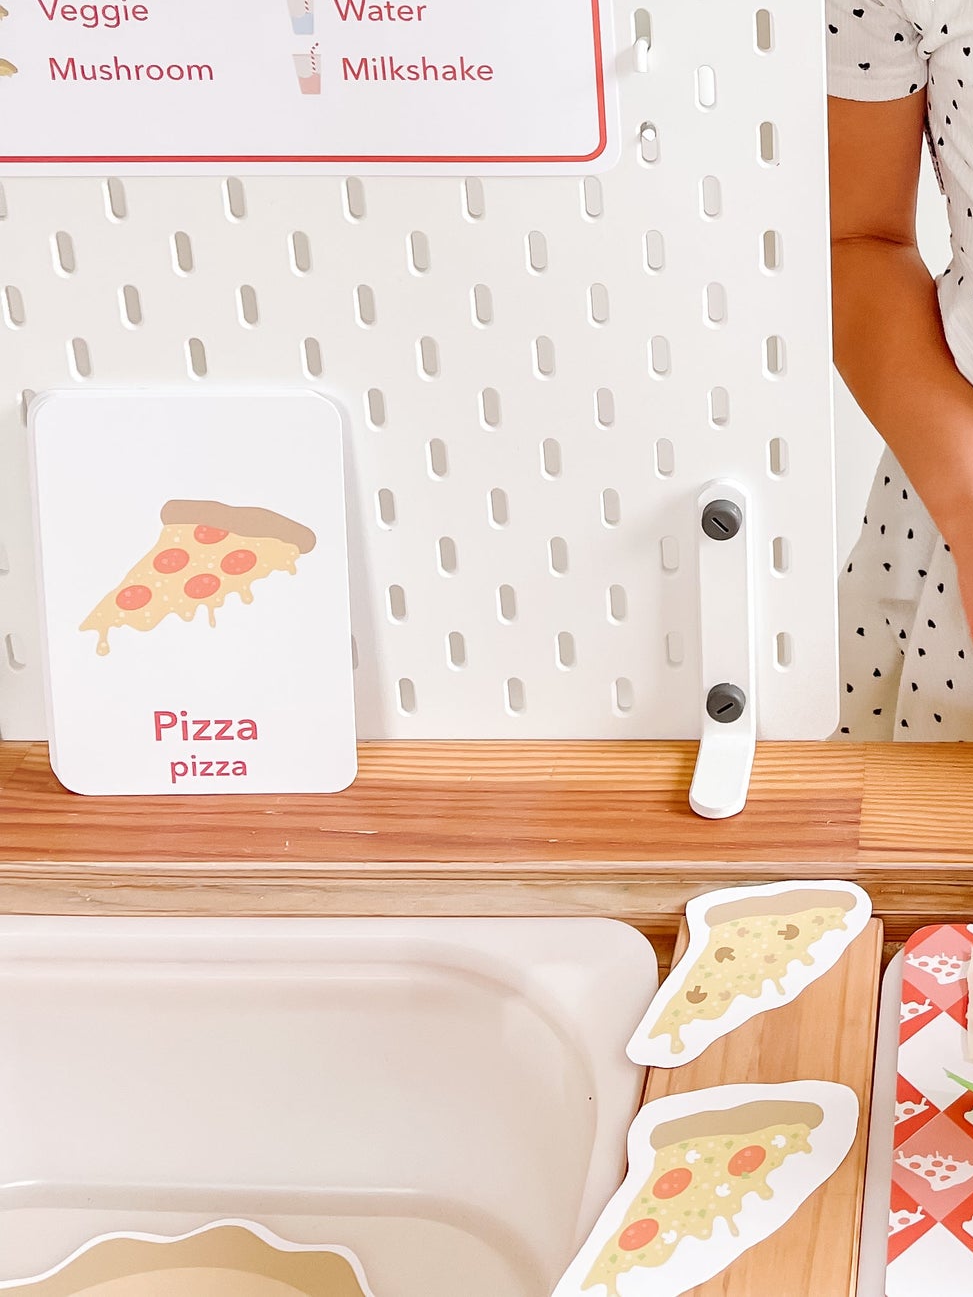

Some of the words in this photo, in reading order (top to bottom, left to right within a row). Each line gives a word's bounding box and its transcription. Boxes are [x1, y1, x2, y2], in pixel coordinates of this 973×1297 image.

[48, 57, 214, 82] Mushroom
[341, 55, 494, 82] Milkshake
[153, 710, 259, 742] Pizza
[170, 754, 248, 784] pizza
